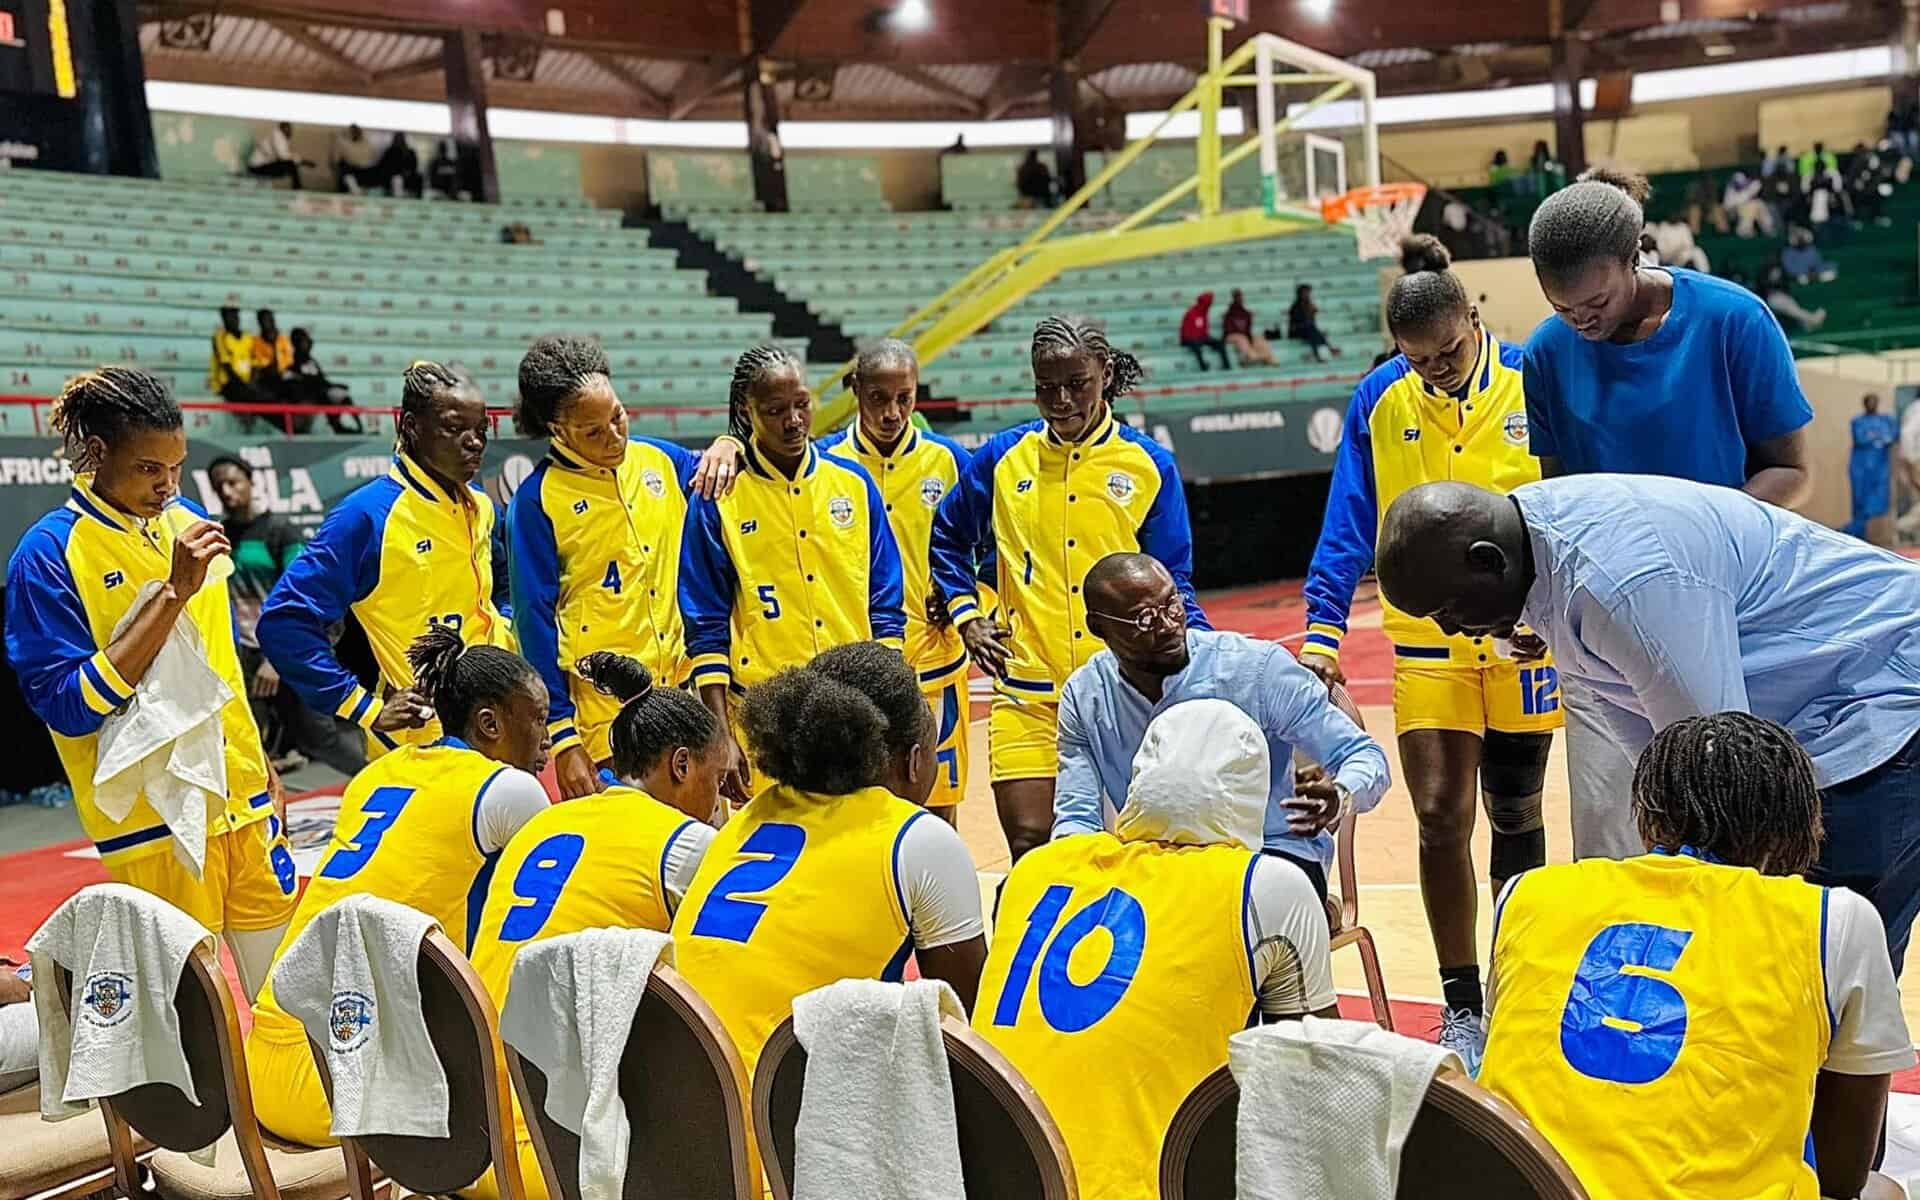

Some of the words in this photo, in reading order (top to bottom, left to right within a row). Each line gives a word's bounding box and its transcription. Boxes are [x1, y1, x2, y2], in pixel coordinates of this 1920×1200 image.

[0, 457, 73, 484] FRICA
[601, 560, 622, 594] 4
[757, 585, 780, 620] 5
[1023, 551, 1033, 585] 1
[1519, 666, 1559, 714] 12
[321, 786, 414, 880] 3
[499, 833, 585, 942] 9
[692, 823, 806, 943] 2
[993, 884, 1146, 1034] 10
[1560, 922, 1693, 1085] 6
